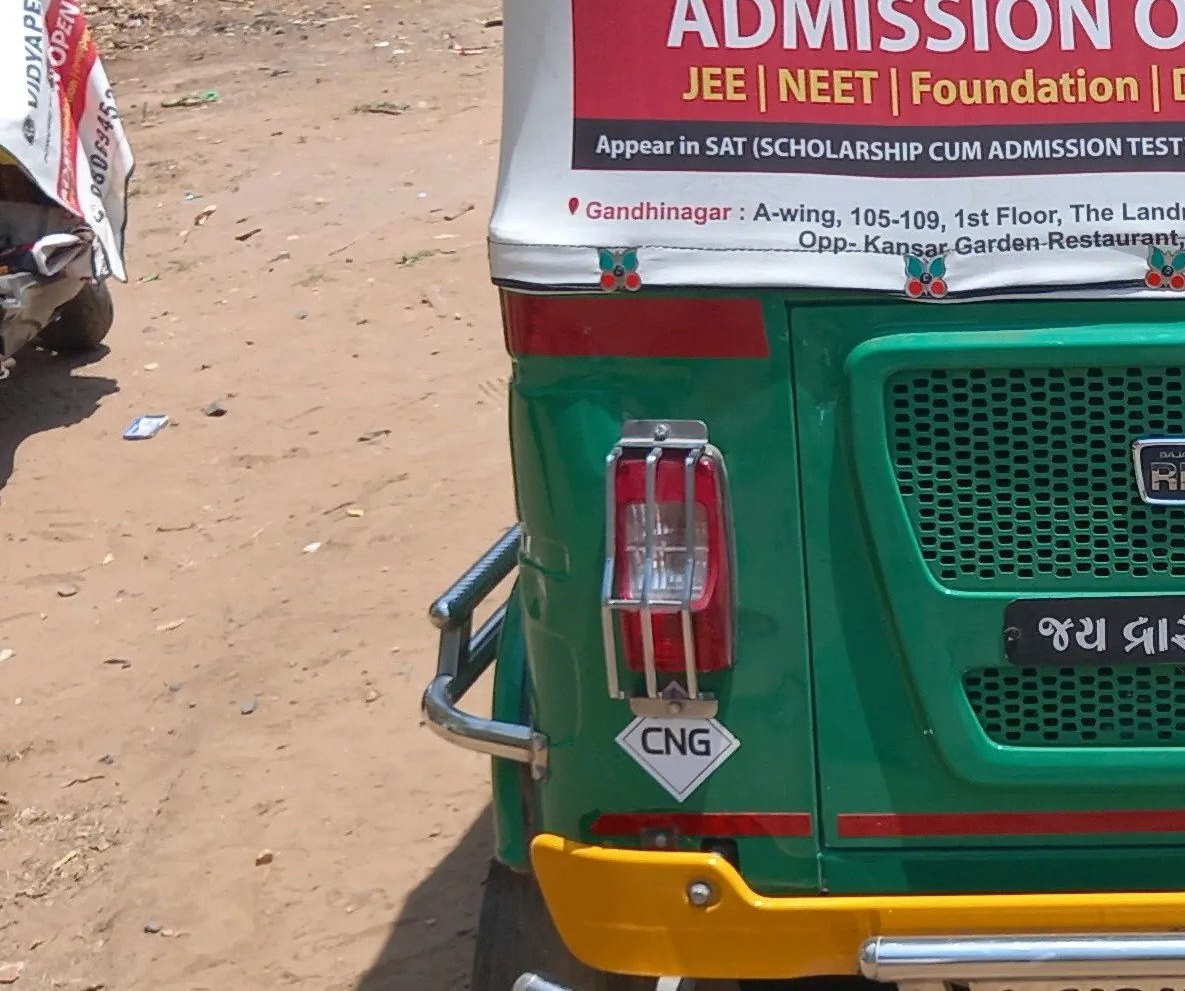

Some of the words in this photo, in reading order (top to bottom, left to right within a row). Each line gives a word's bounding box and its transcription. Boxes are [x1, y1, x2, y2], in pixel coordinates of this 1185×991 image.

[49, 0, 79, 62] OPEN
[682, 65, 747, 103] JEE
[778, 69, 880, 106] NEET
[910, 68, 1139, 107] Foundation
[595, 135, 674, 160] Appear
[680, 135, 700, 156] in
[705, 137, 747, 157] SAT
[752, 136, 924, 162] (SCHOLARSHIP
[929, 140, 982, 161] CUM
[988, 137, 1123, 160] ADMISSION
[586, 202, 732, 225] Gandhinagar
[752, 202, 842, 228] A-wing,
[850, 207, 946, 232] 105-109,
[954, 208, 989, 228] 1st
[996, 206, 1062, 229] Floor,
[1069, 204, 1113, 223] The
[864, 235, 949, 258] Kansar
[955, 235, 1041, 255] Garden
[1047, 231, 1185, 250] Restaurant,
[1038, 616, 1107, 652] જય
[641, 727, 712, 756] CNG
